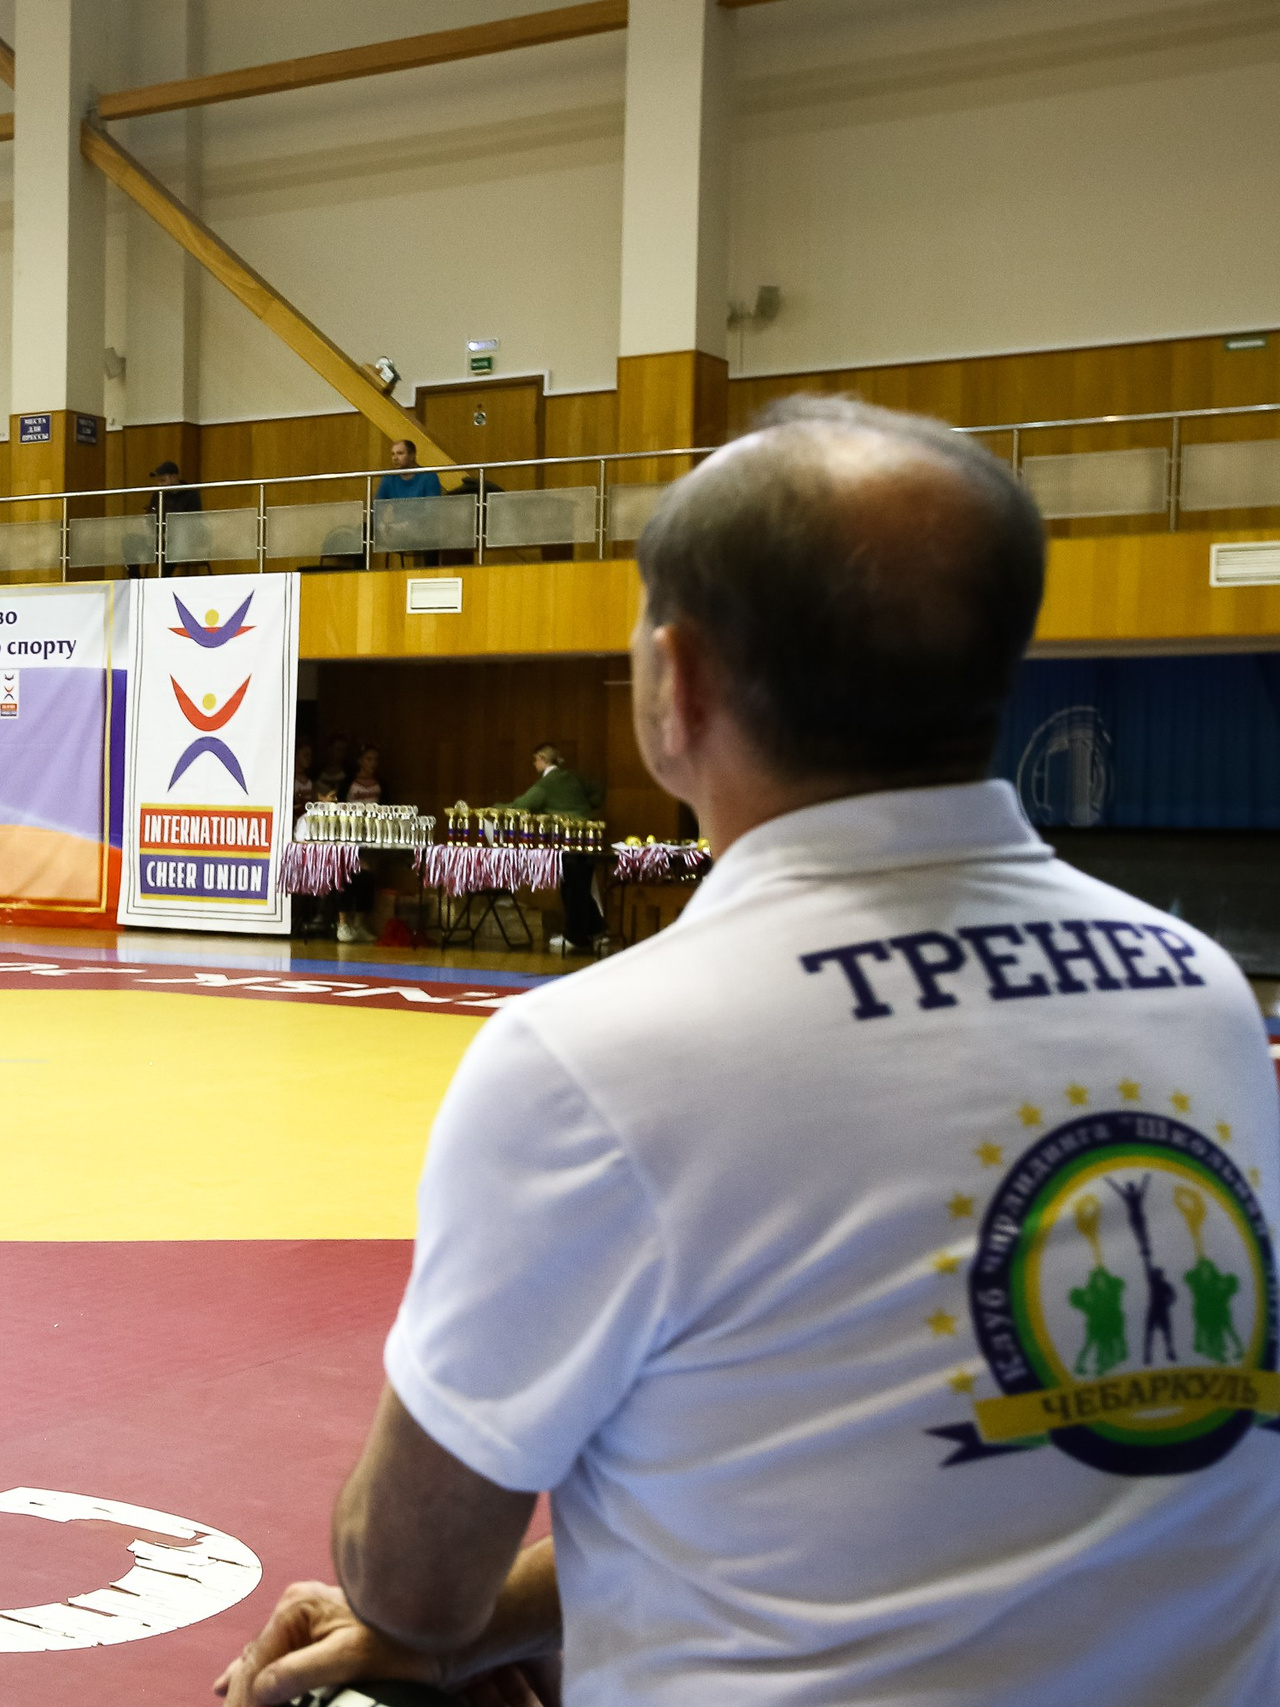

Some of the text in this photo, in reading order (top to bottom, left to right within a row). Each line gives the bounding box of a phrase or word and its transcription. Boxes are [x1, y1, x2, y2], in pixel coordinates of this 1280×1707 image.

[7, 638, 77, 660] спорту
[144, 815, 270, 847] INTERNATIONAL
[146, 861, 263, 892] CHEER UNION
[799, 920, 1207, 1021] ТРЕНЕР
[1041, 1374, 1259, 1420] ЧЕБАРКУЛЬ
